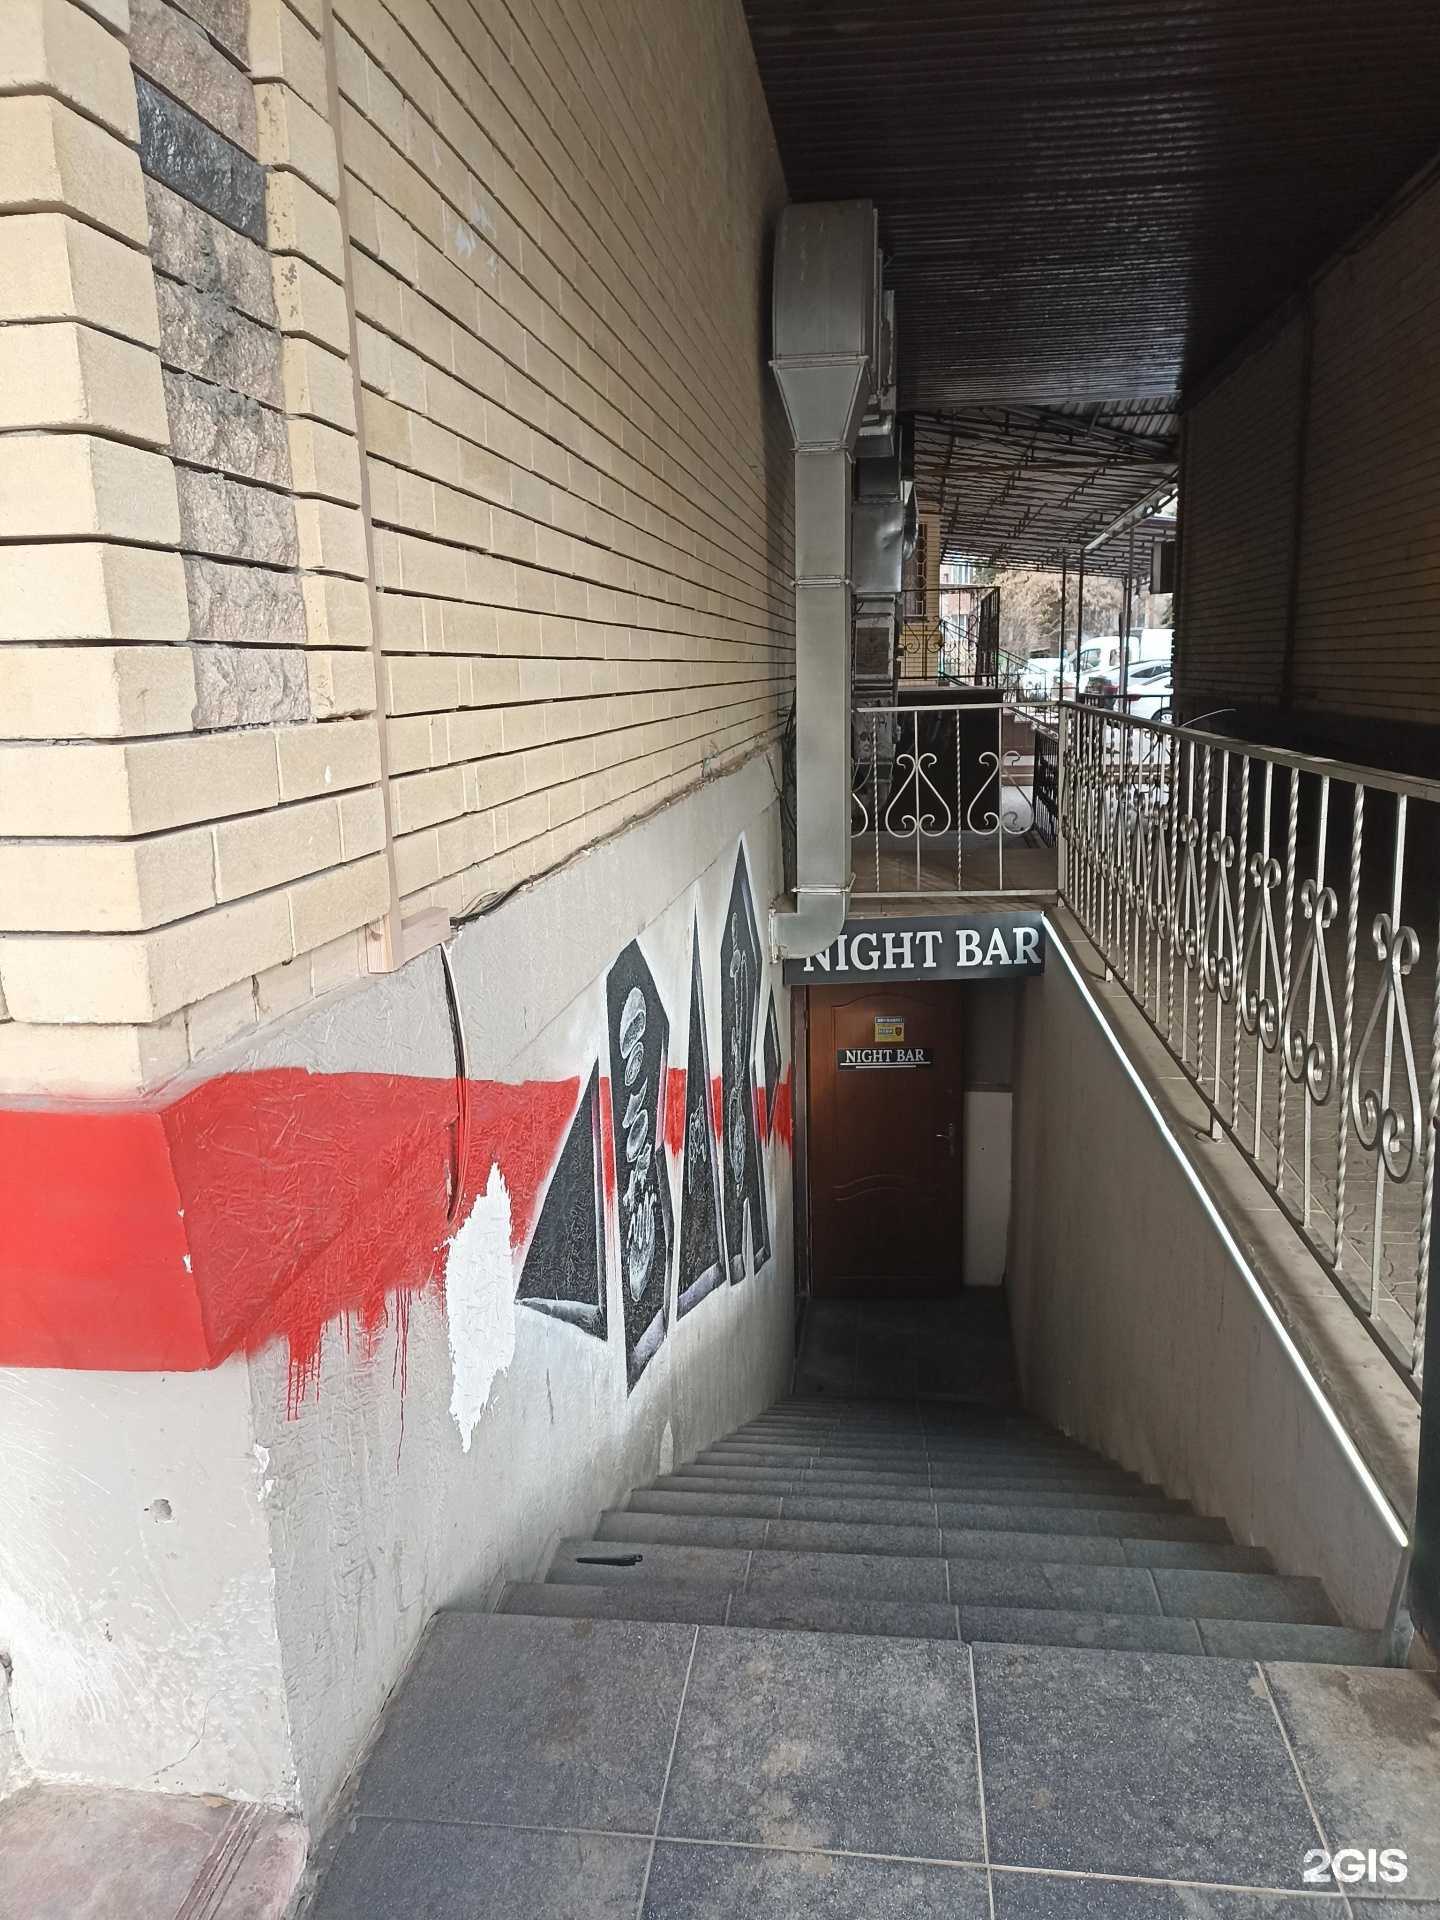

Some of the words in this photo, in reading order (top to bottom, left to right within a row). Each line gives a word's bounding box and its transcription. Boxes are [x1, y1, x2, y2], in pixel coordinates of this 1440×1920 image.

[956, 927, 1041, 967] BAR
[846, 1050, 892, 1062] NIGHT
[896, 1048, 924, 1061] BAR
